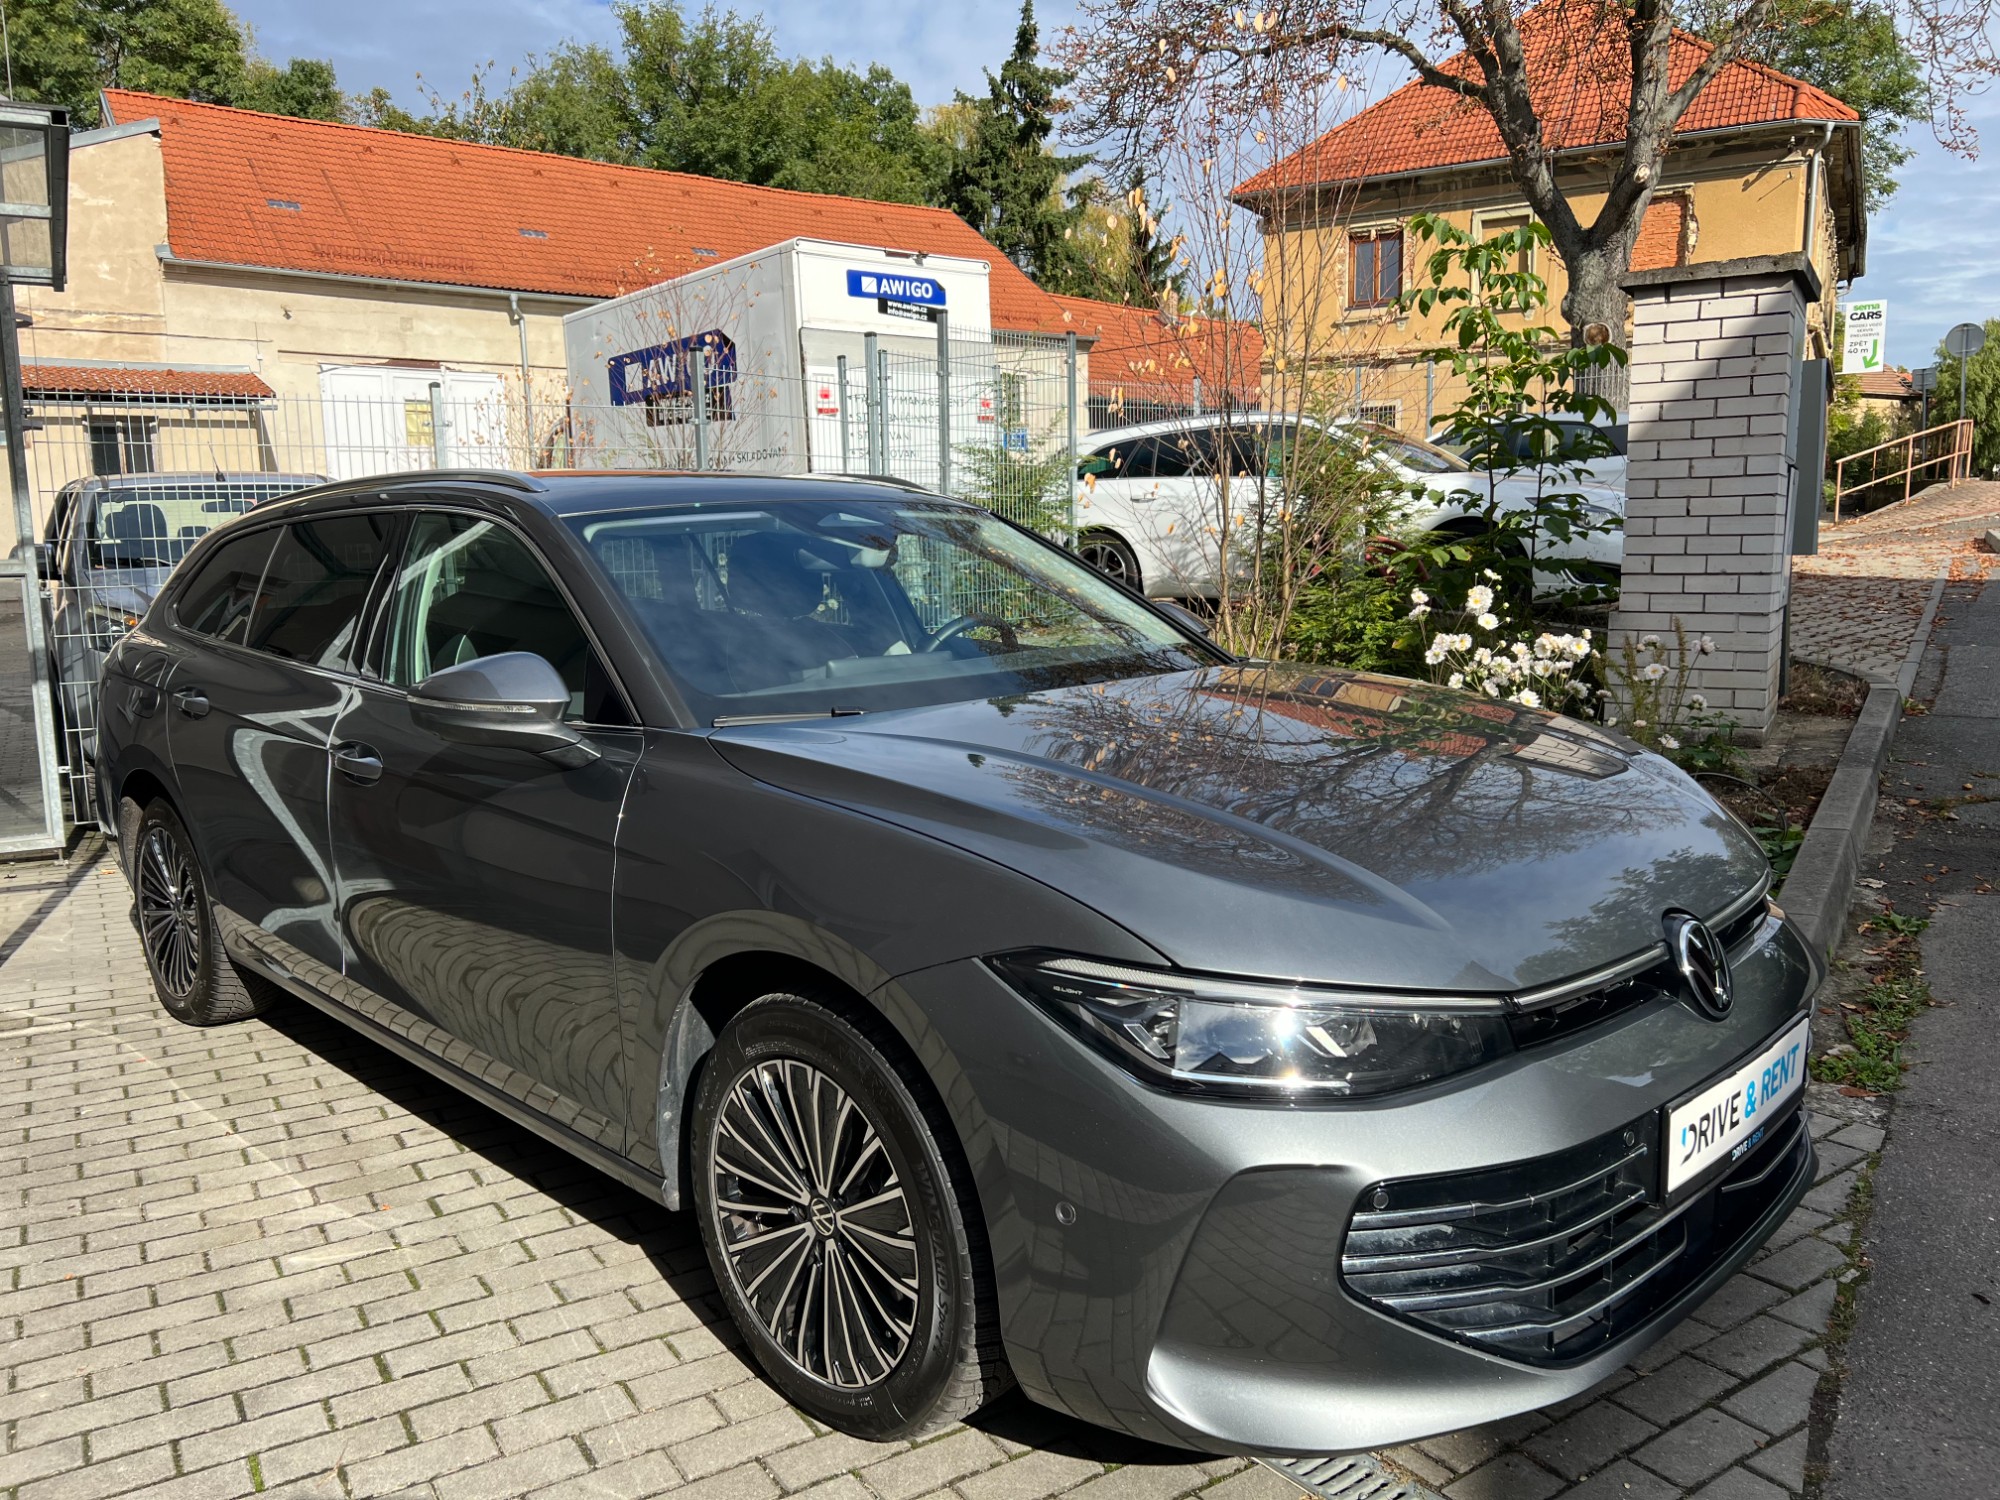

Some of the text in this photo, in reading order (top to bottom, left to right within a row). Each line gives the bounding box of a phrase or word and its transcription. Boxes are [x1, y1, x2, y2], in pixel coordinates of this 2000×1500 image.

[880, 278, 933, 299] AWIGO
[887, 300, 928, 313] www.awigo.cz
[1853, 303, 1880, 311] sema
[887, 307, 928, 321] info@awigo.cz
[1850, 310, 1882, 321] CARS
[1681, 1042, 1800, 1166] DRIVE & RENT
[1731, 1140, 1749, 1162] DRIVE
